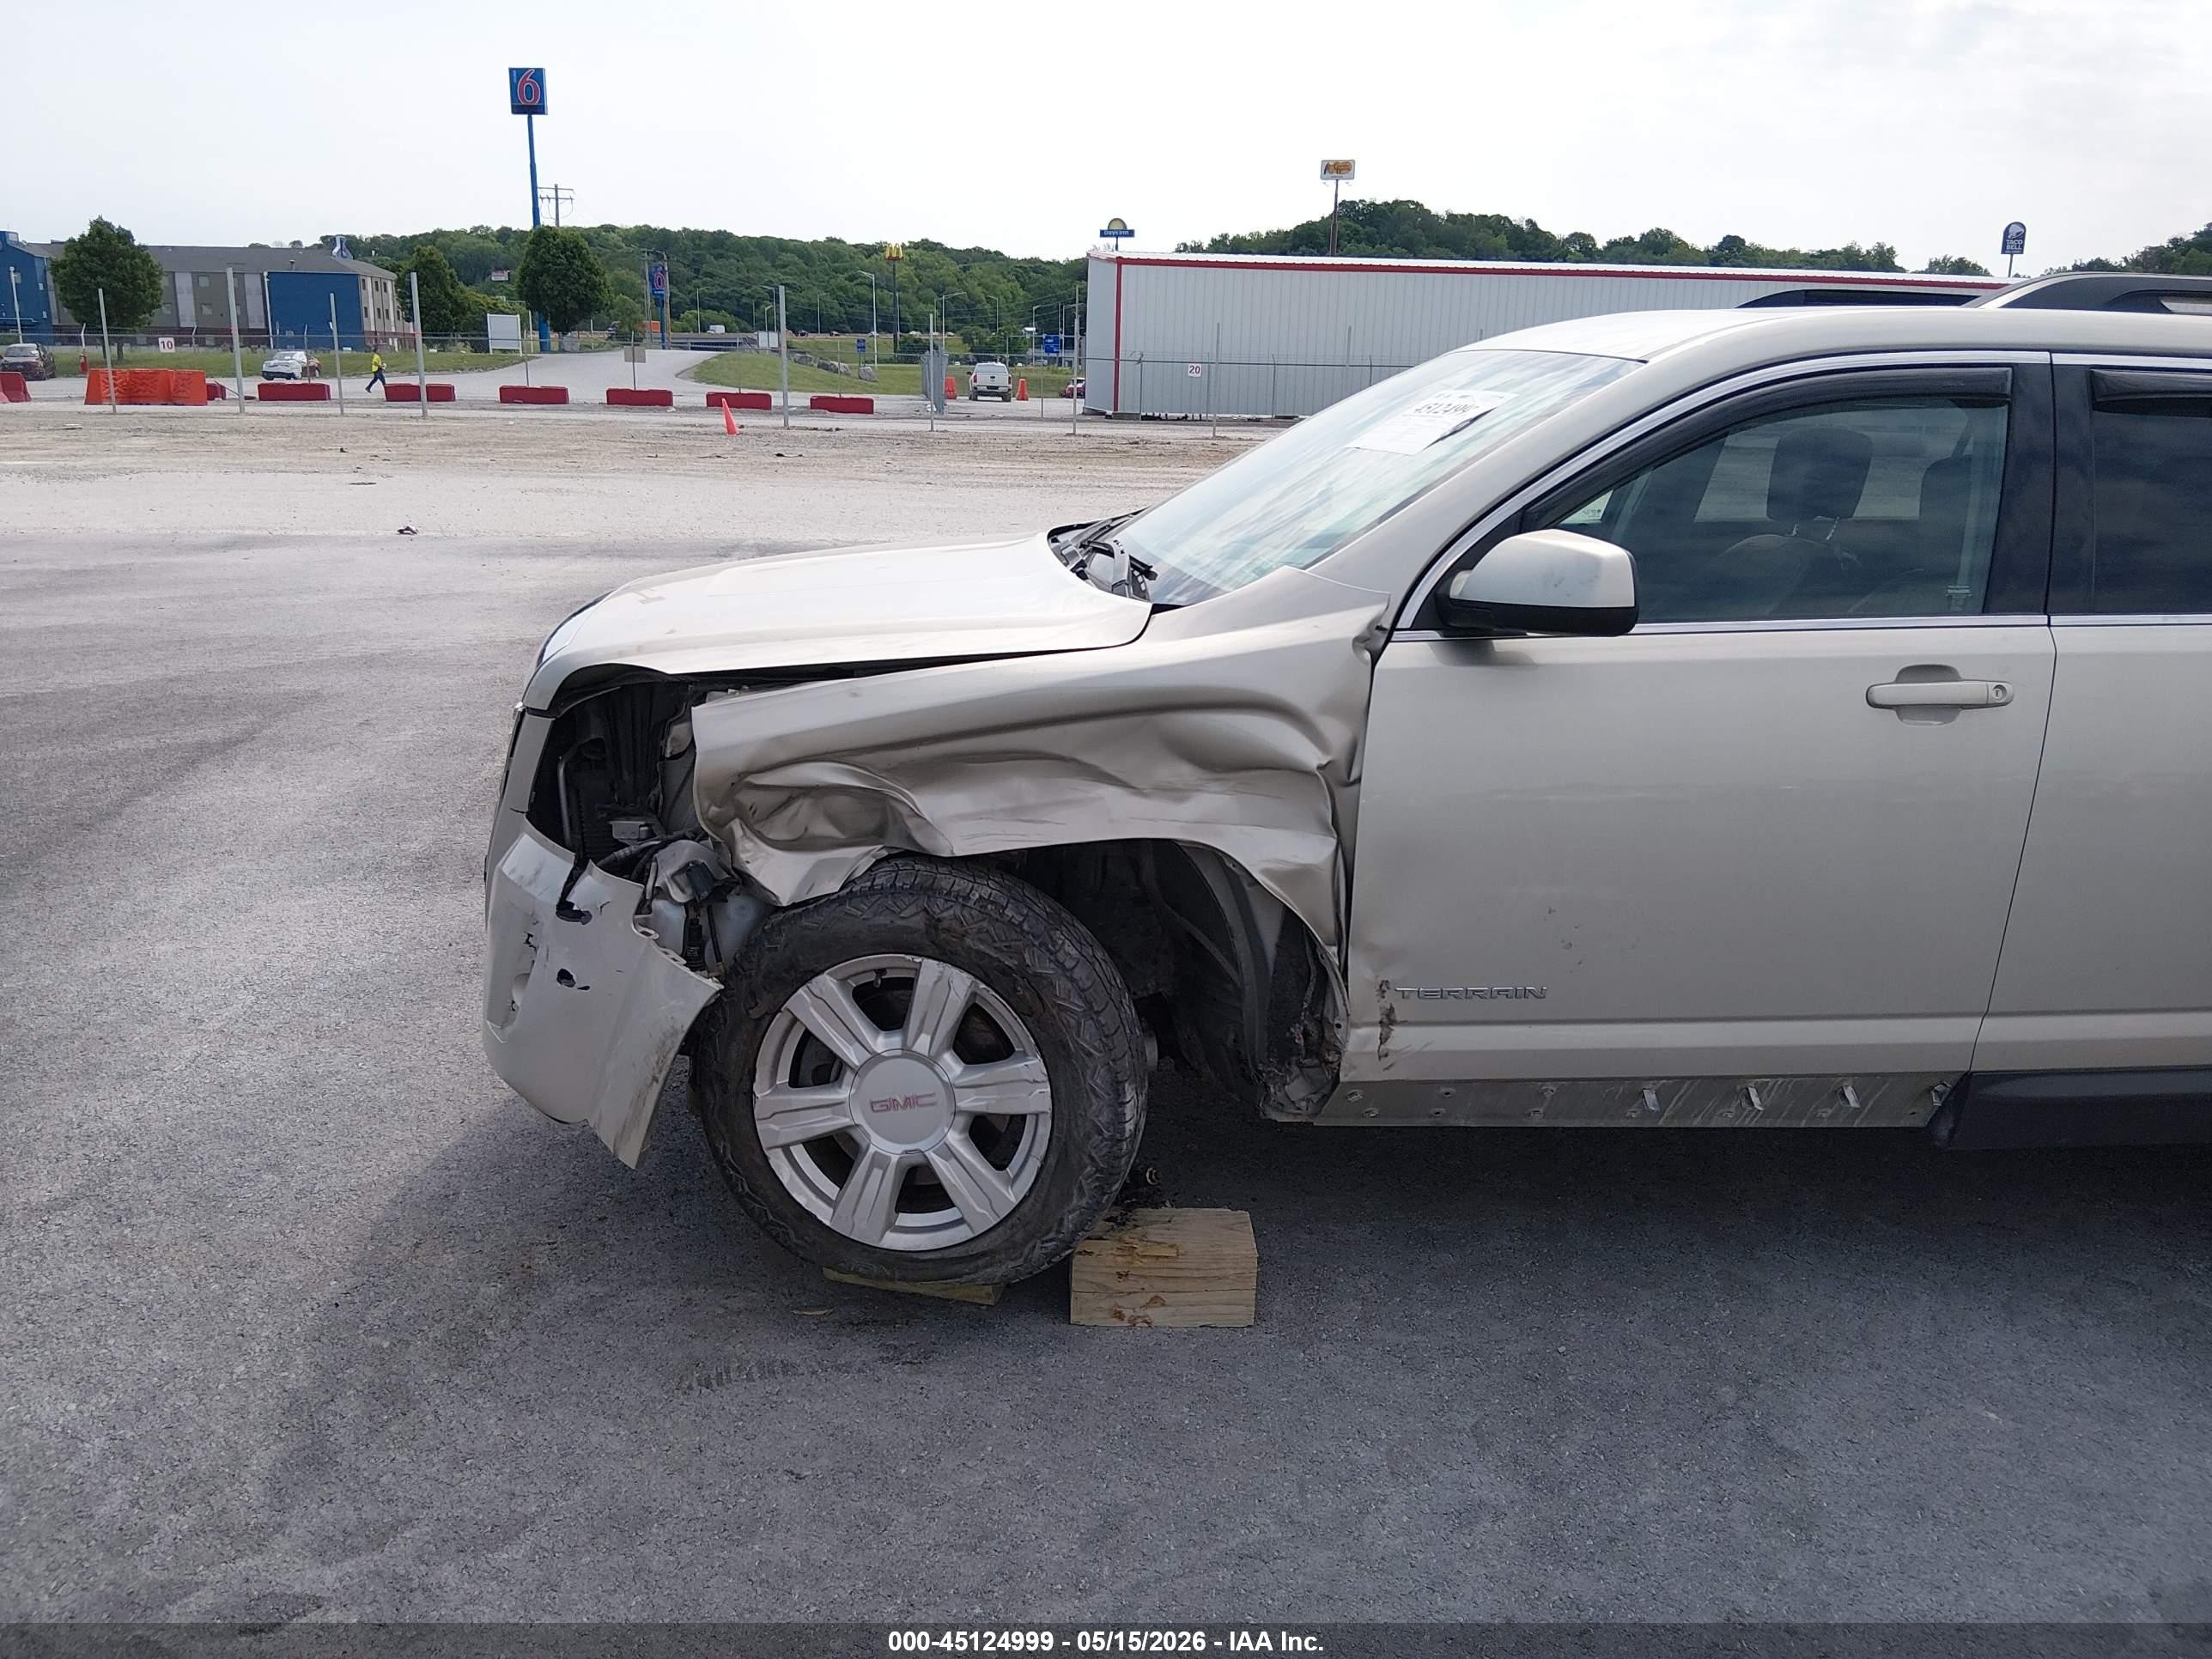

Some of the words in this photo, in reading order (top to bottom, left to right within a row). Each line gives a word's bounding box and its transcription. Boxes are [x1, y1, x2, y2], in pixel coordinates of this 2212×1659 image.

[517, 69, 541, 105] 6
[160, 340, 173, 350] 10
[1188, 365, 1201, 374] 20
[1395, 987, 1547, 1001] TERRAIN
[870, 1092, 937, 1113] GMC
